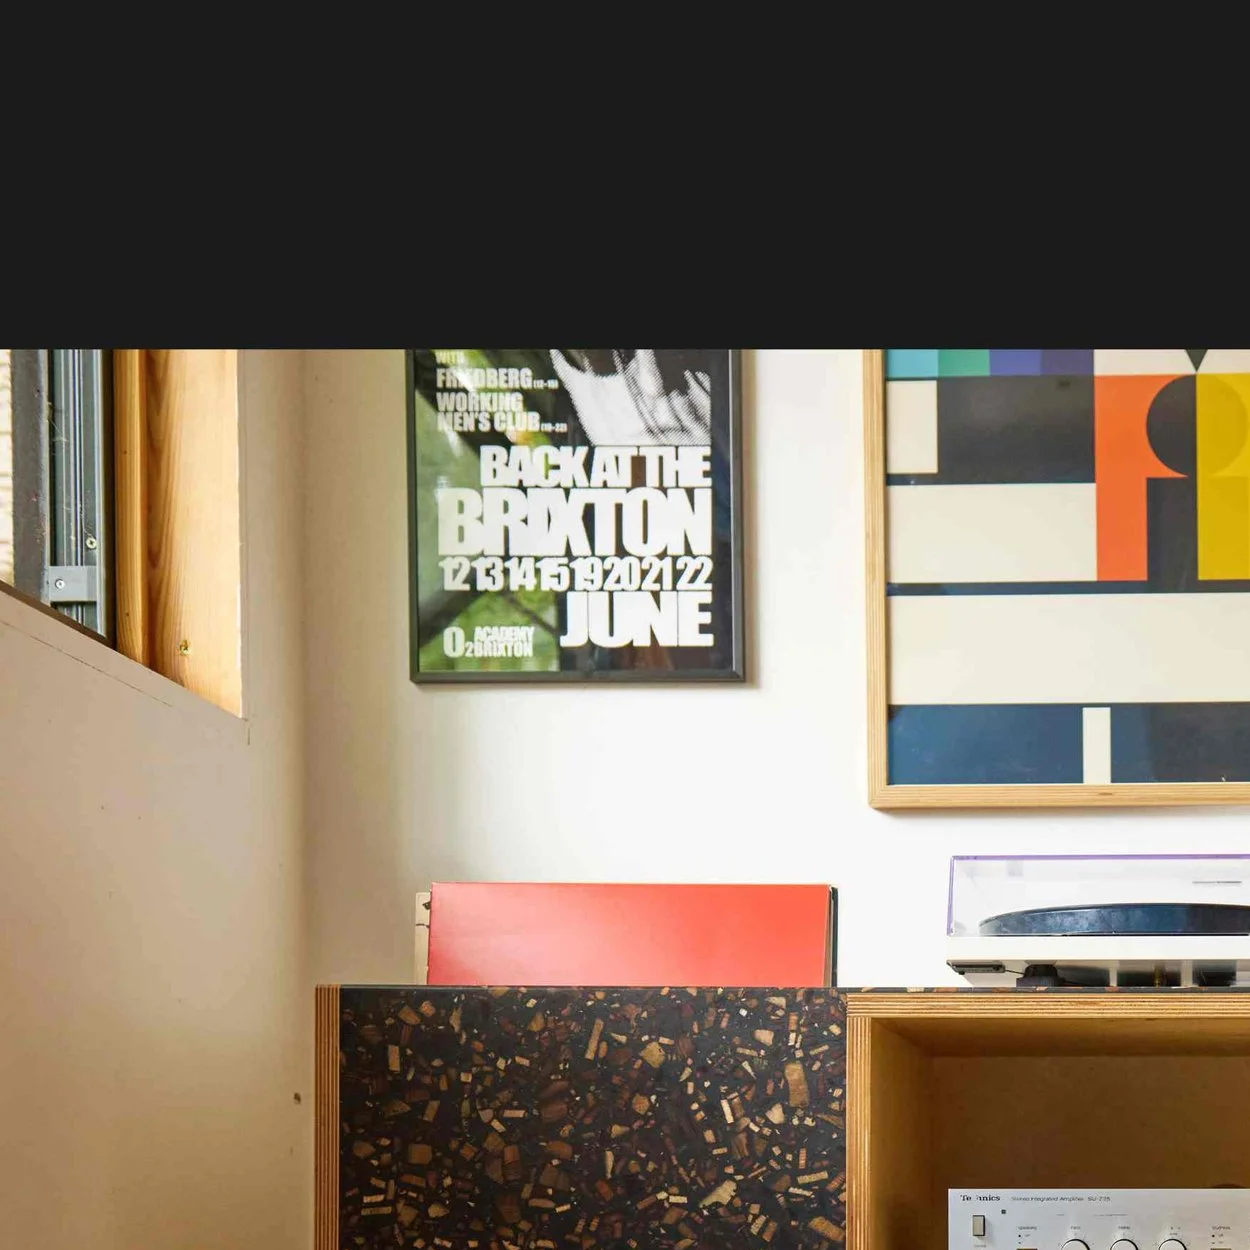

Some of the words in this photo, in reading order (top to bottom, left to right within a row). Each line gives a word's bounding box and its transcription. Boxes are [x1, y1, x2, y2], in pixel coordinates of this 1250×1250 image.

[436, 368, 532, 388] FRDBERG
[436, 392, 523, 412] WORKING
[437, 411, 491, 432] MEN'S
[494, 411, 540, 432] CLUB
[480, 445, 589, 487] BACK
[590, 445, 638, 487] AT
[638, 445, 712, 487] THE
[438, 488, 713, 556] BRIXTON
[559, 591, 714, 647] JUNE
[474, 626, 535, 641] ACADEMY
[474, 641, 534, 657] BRIXTON
[960, 1194, 1001, 1202] Tenics
